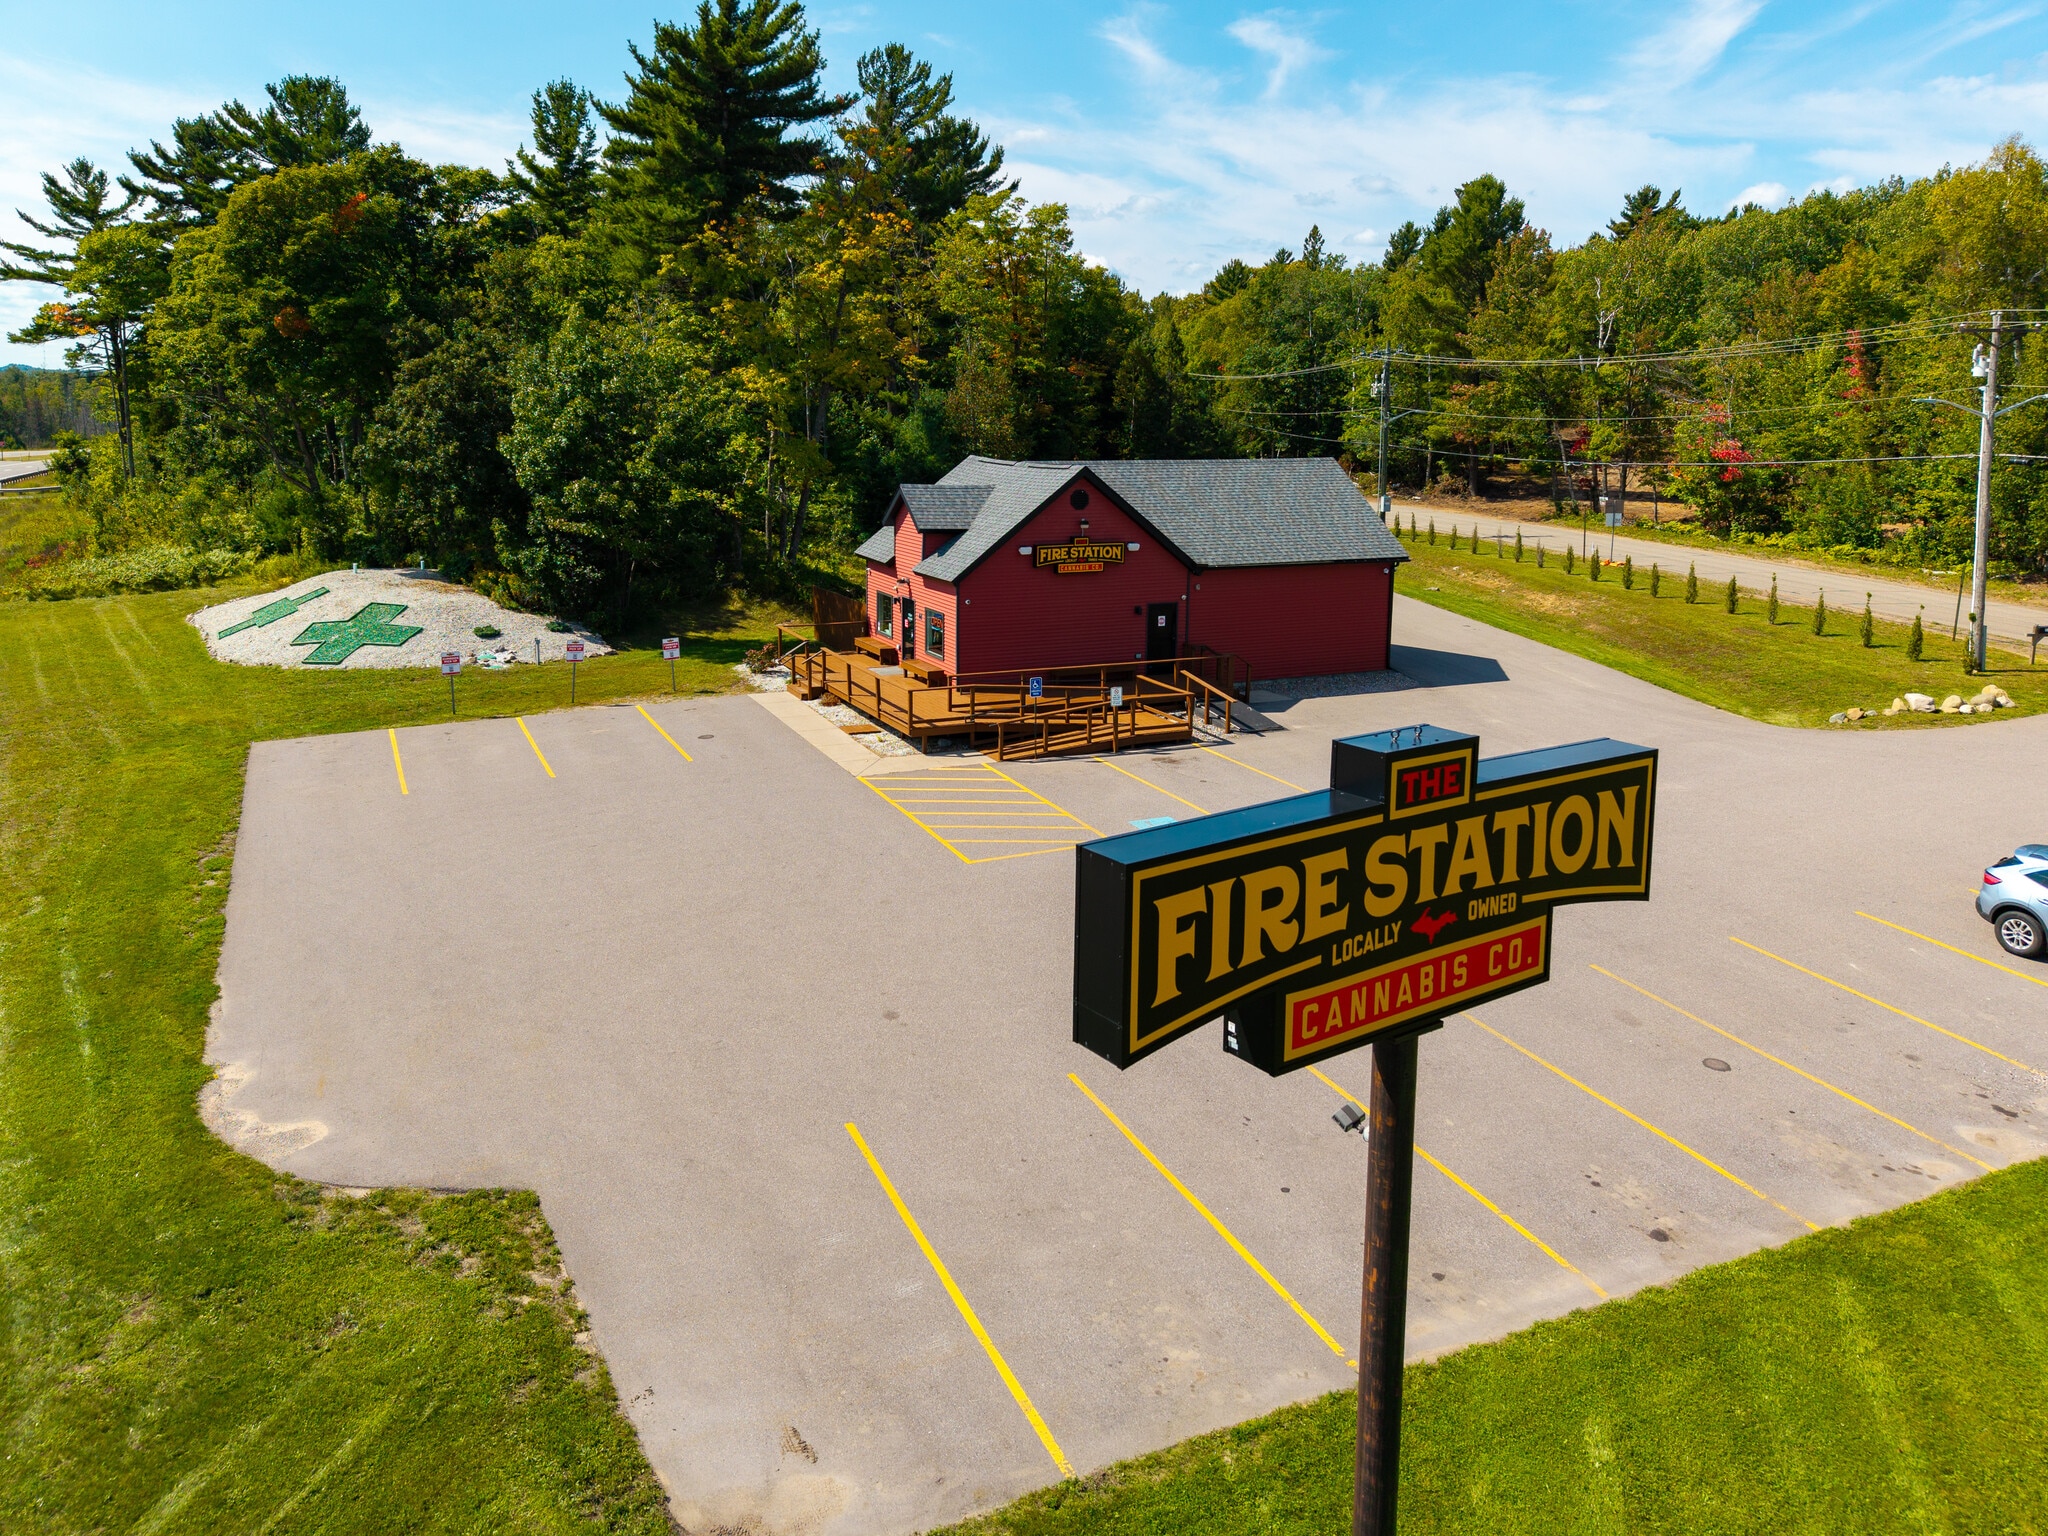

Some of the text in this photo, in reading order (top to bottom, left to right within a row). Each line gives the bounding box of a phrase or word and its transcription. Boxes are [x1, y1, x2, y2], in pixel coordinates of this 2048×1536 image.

[1040, 546, 1121, 562] FIRE STATION
[1402, 762, 1461, 805] THE
[1152, 785, 1640, 1008] FIRE STATION
[1331, 891, 1517, 967] LOCALLY OWNED
[1300, 936, 1533, 1041] CANNABIS CO.
